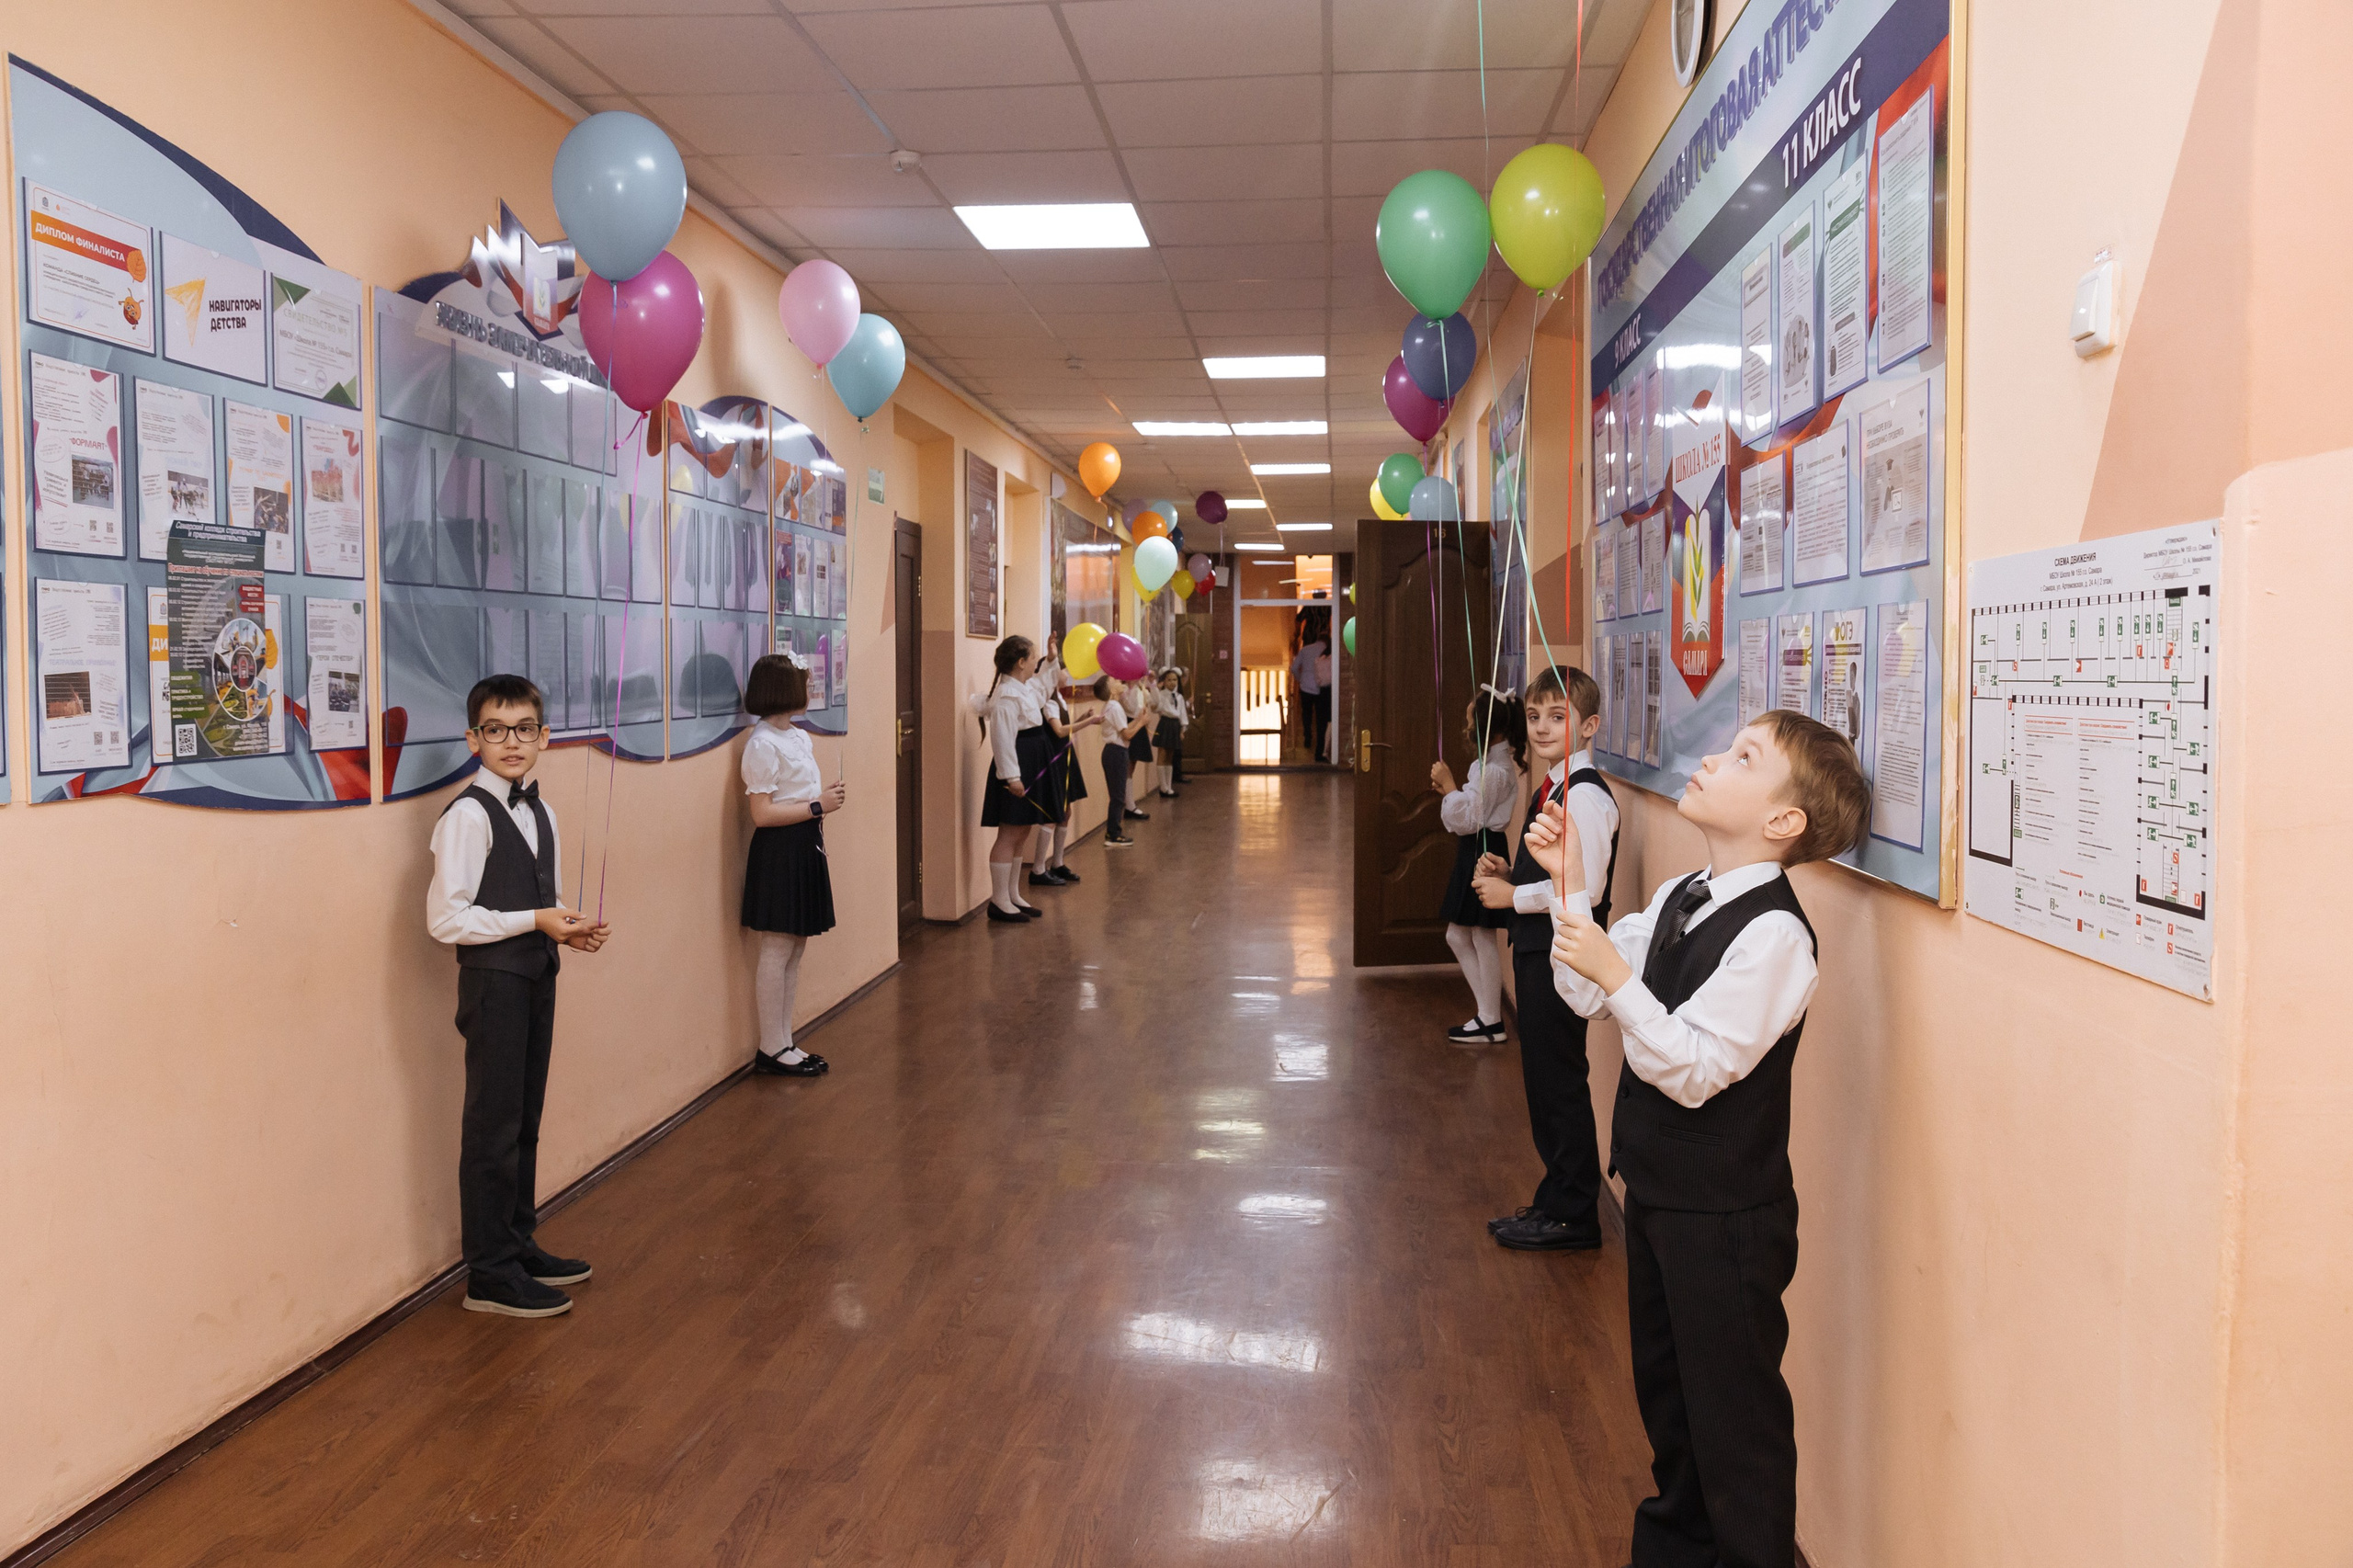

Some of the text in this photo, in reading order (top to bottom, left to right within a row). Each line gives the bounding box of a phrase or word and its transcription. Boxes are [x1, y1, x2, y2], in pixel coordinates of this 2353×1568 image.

[1782, 132, 1799, 188] 11
[1802, 57, 1862, 169] КЛАСС
[1597, 152, 1686, 312] ГОСУДАРСТВЕННАЯ
[1686, 46, 1762, 196] ИТОГОВАЯ
[35, 222, 126, 262] ДИПЛОМ ФИНАЛИСТА
[209, 299, 262, 312] НАВИГАТОРЫ
[210, 316, 247, 333] ДЕТСТВА
[1619, 312, 1642, 363] КЛАСС
[1676, 433, 1722, 483] ШКОЛА № 155
[2054, 552, 2097, 567] СХЕМА ДВИЖЕНИЯ
[2087, 566, 2102, 575] Самара
[1840, 621, 1853, 641] ОГЭ
